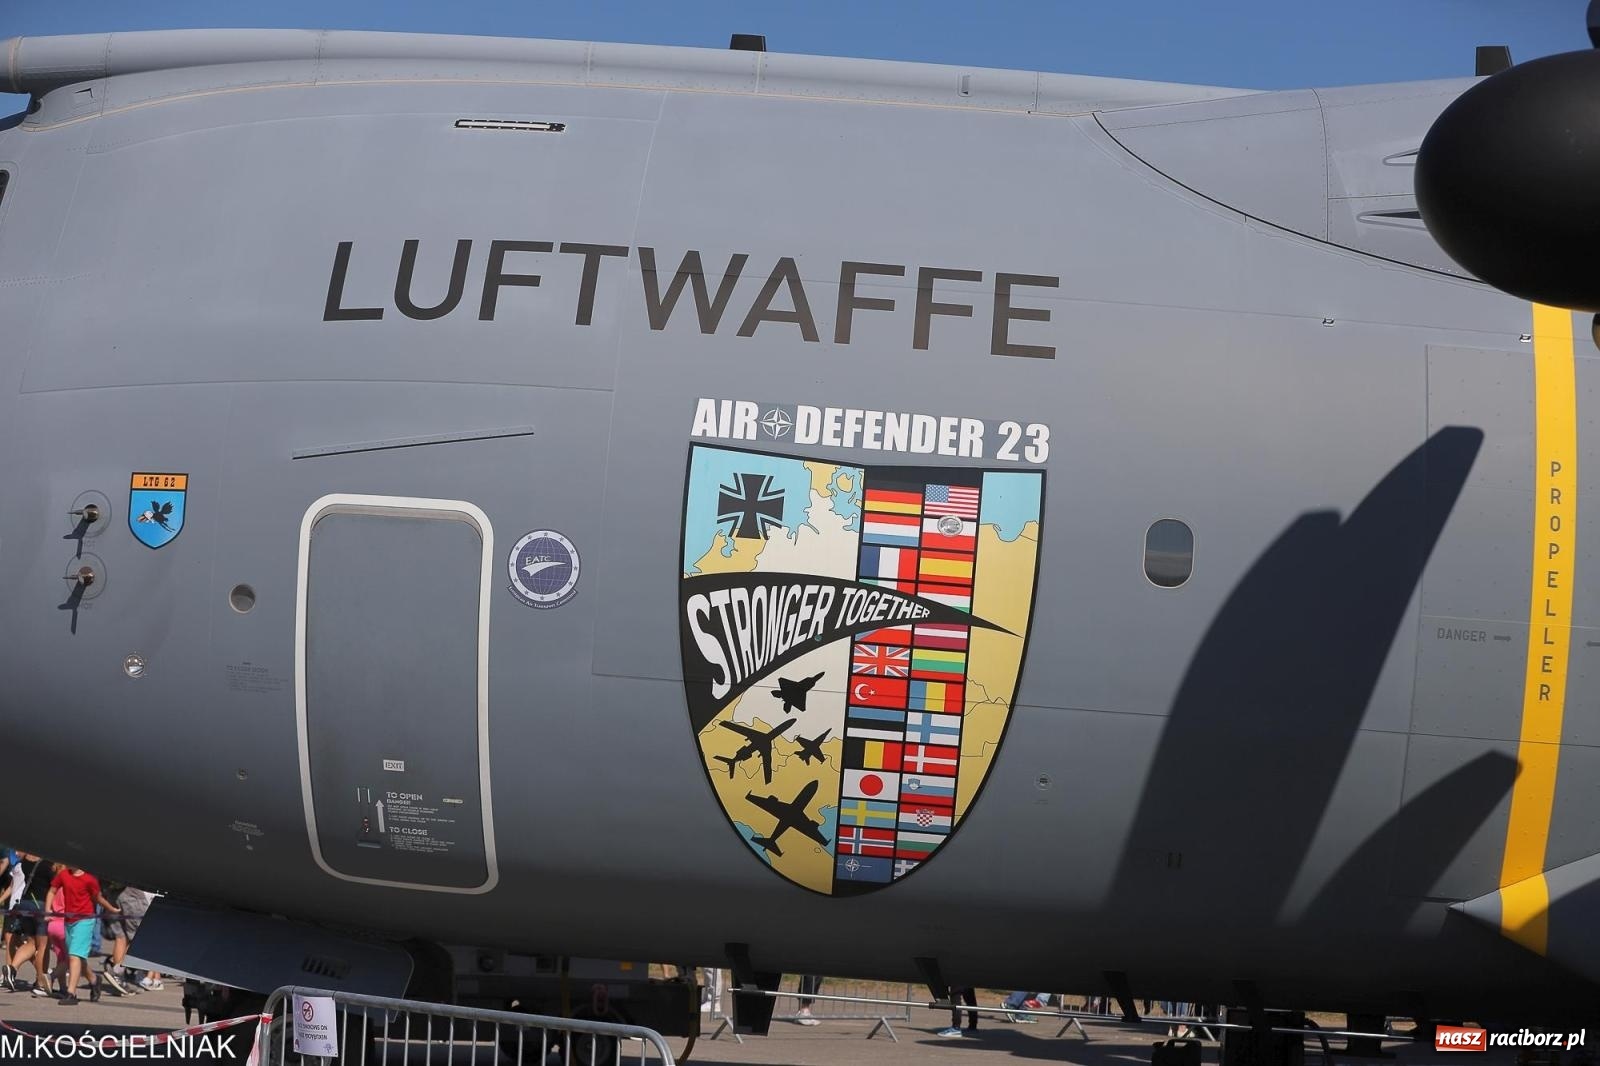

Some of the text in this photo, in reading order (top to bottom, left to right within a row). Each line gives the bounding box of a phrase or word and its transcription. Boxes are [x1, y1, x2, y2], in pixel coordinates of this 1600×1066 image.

[323, 239, 1060, 360] LUFTWAFFE
[691, 398, 1050, 464] AIR DEFENDER 23
[143, 476, 175, 488] LTG 62
[525, 555, 551, 566] EATC
[1538, 461, 1562, 702] PROPELLER
[1437, 627, 1487, 642] DANGER
[686, 584, 930, 700] STRONGER TOGETHER
[385, 761, 403, 769] EXIT
[386, 791, 423, 801] TO OPEN
[402, 828, 428, 836] CLOSE
